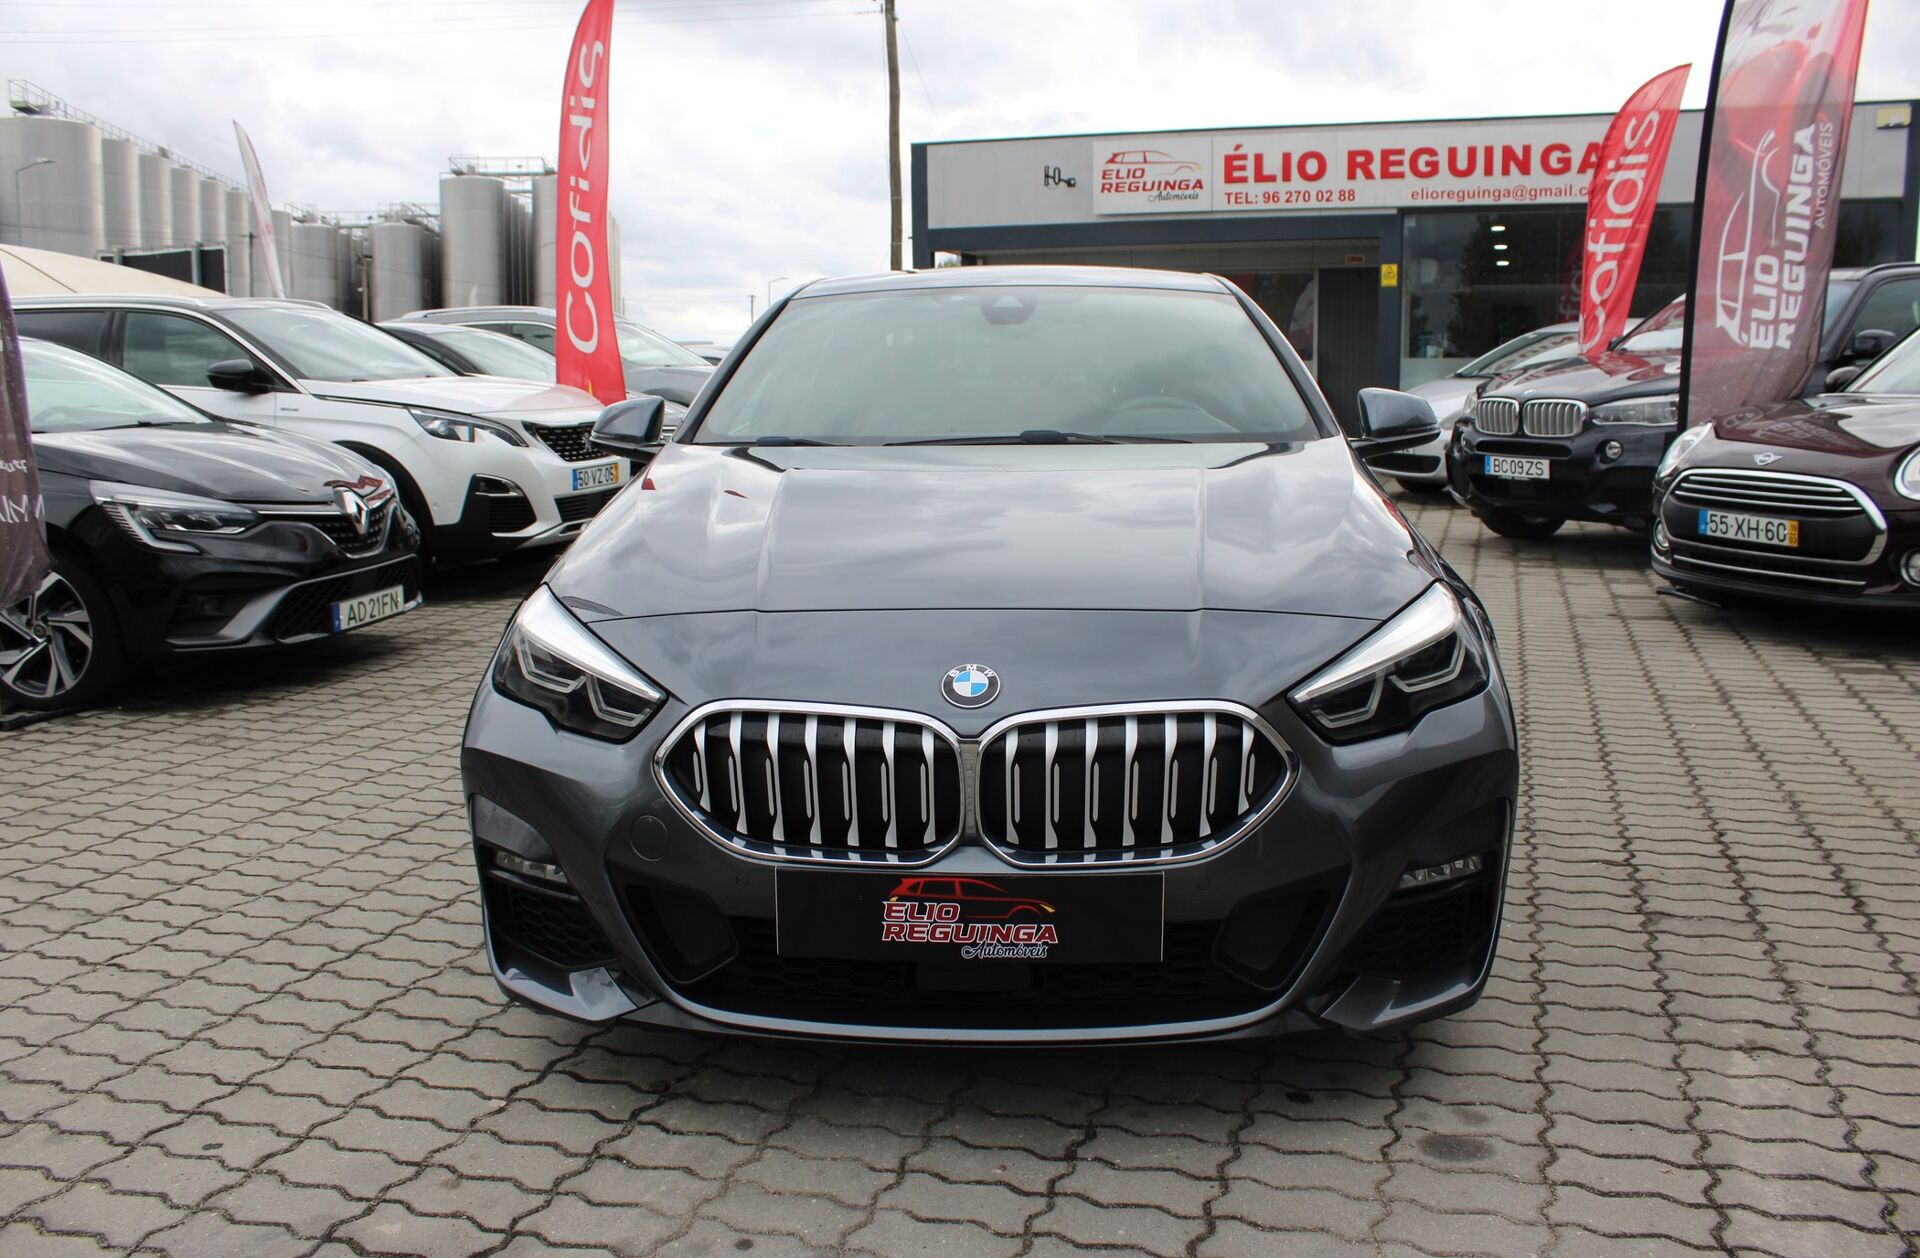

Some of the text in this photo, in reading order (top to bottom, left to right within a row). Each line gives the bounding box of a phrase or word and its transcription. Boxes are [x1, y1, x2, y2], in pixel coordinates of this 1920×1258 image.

[1101, 167, 1146, 180] ELIO
[1224, 142, 1602, 184] ÉLIO REGUINGA
[1100, 178, 1204, 193] REGUINGA
[1814, 122, 1833, 229] AUTOMÓVEIS
[566, 39, 604, 354] Cofidis
[1224, 189, 1356, 205] TEL: 96 270 02 88
[1411, 184, 1587, 203] elioreguinga@gmail.c
[1775, 123, 1815, 350] REGUINGA
[1749, 254, 1780, 350] ELIO
[949, 664, 995, 677] BMW
[882, 901, 960, 922] ELIO
[882, 921, 1058, 943] REGUINGA
[961, 941, 1048, 959] Automóveis
